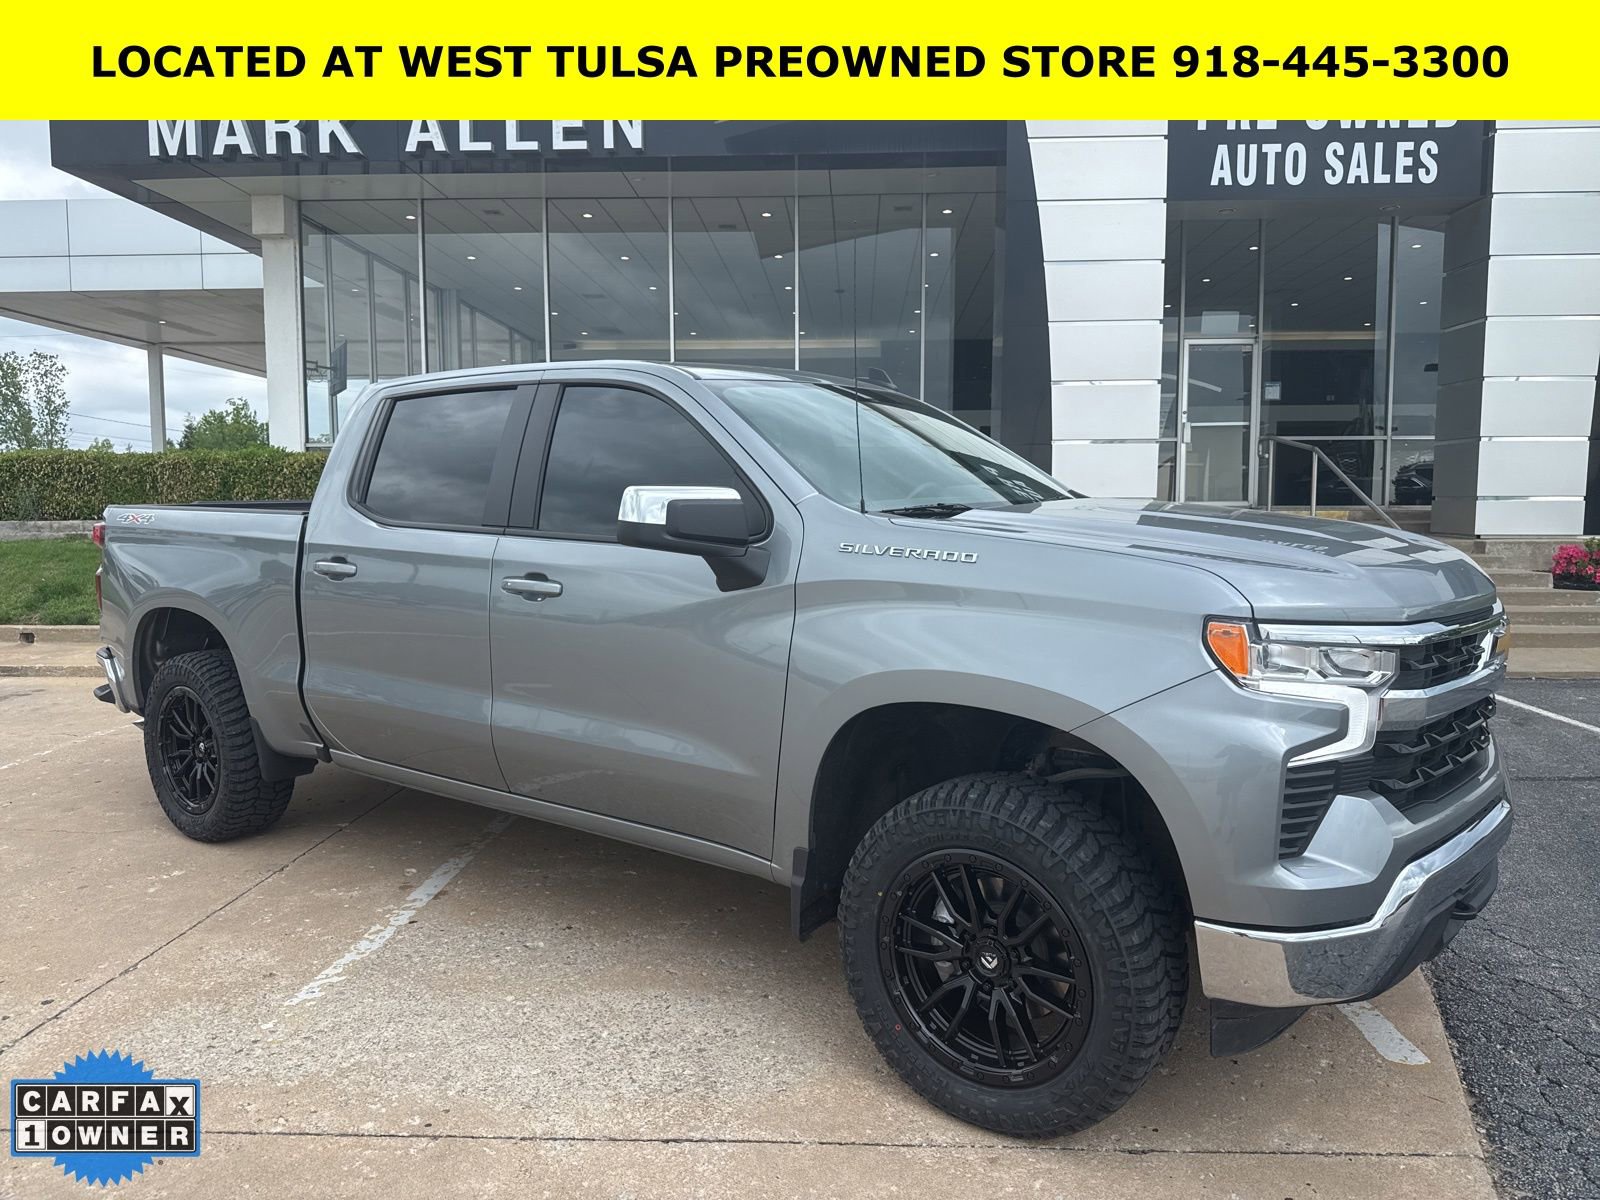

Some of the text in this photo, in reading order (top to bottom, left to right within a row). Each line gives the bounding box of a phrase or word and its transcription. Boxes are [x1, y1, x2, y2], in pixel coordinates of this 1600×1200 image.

[1210, 140, 1439, 186] AUTO SALES
[838, 542, 978, 563] SILVERADO
